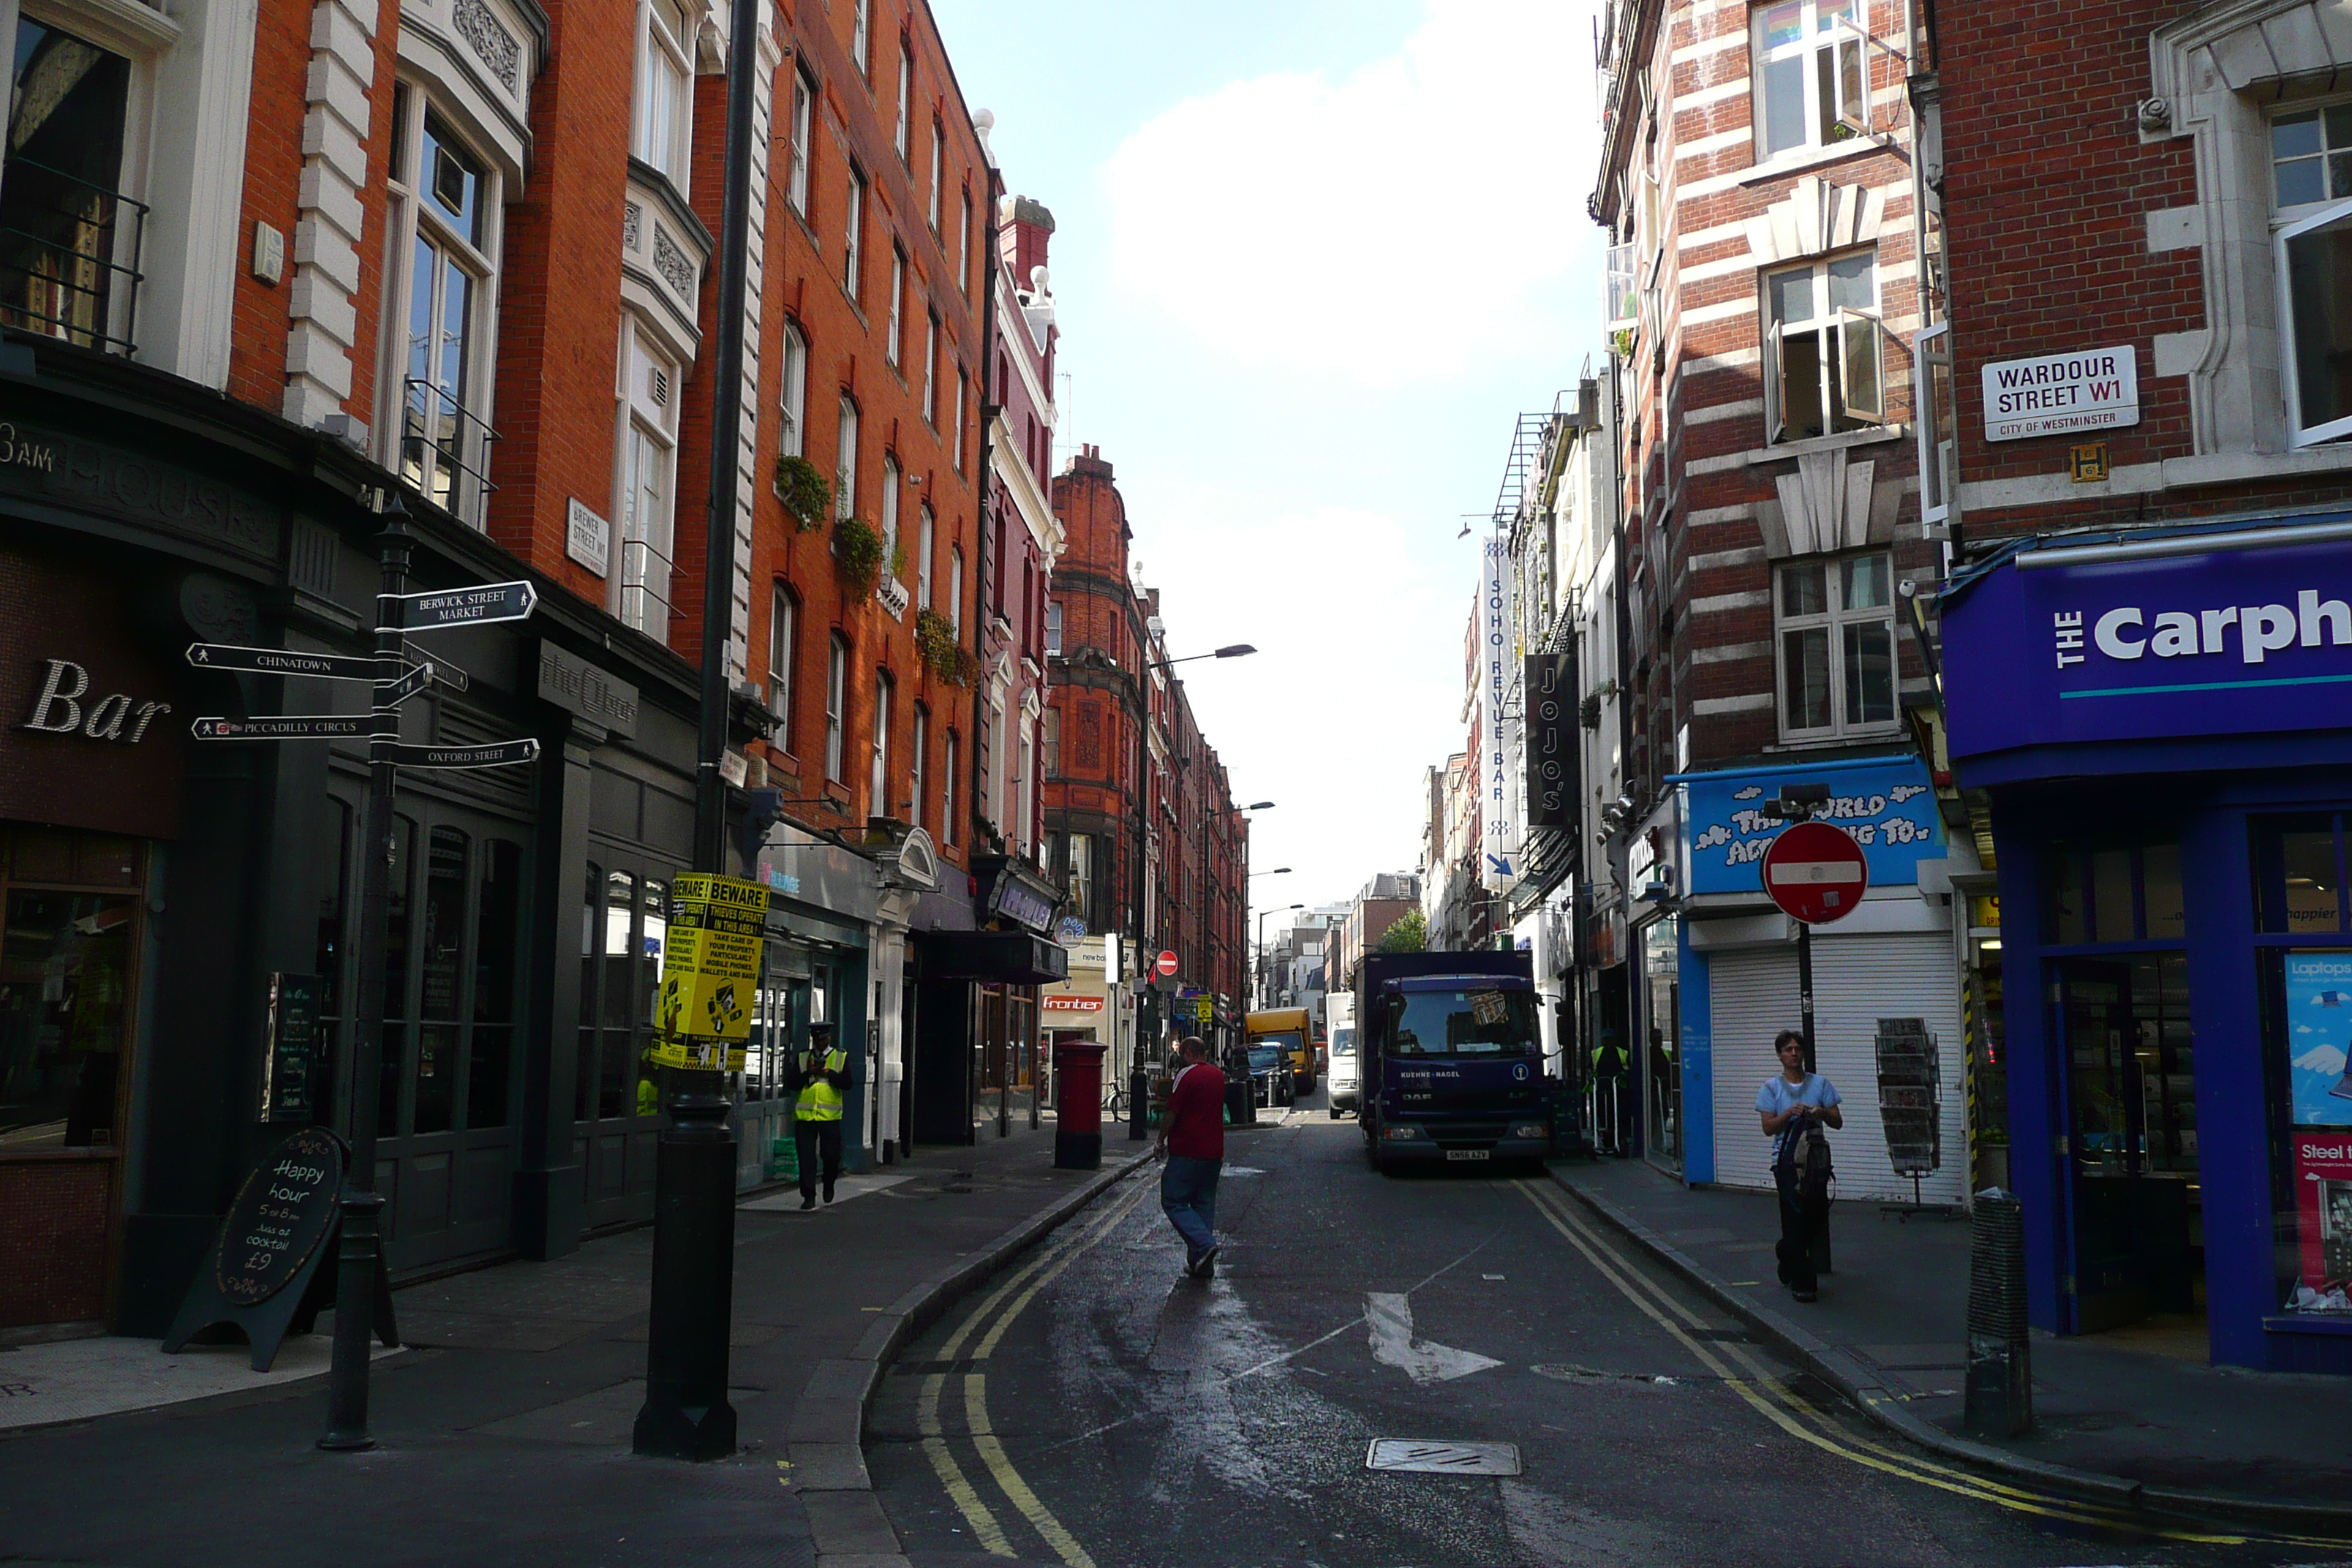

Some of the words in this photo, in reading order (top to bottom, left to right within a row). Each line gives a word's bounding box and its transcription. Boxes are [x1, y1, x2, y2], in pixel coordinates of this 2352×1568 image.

[1997, 356, 2115, 388] WARDOUR
[1999, 385, 2079, 412] STREET
[2089, 380, 2121, 402] W1
[2000, 423, 2021, 435] CITY
[2027, 422, 2038, 431] OF
[2042, 412, 2116, 430] WESTMINSTER
[573, 505, 599, 535] BREWER
[573, 524, 596, 551] STREET
[597, 540, 606, 557] W1
[420, 595, 464, 610] BERWICK
[468, 590, 507, 604] STREET
[439, 606, 486, 621] MARKET
[1490, 579, 1504, 646] SOHO
[2054, 611, 2085, 669] THE
[257, 655, 332, 671] CHINATOWN
[24, 658, 172, 743] Bar
[1491, 661, 1504, 740] REVUE
[244, 723, 311, 732] PICCADILLY
[315, 722, 357, 732] CIRCUS
[1539, 668, 1564, 810] JOJO'S
[428, 751, 471, 762] OXFORD
[475, 748, 505, 760] STREET
[1493, 752, 1505, 801] BAR
[674, 880, 704, 897] BEWARE
[711, 882, 763, 907] BEWARE
[710, 905, 738, 920] THIEVES
[738, 911, 765, 924] OPERATE
[714, 919, 722, 930] IN
[723, 920, 736, 932] THIS
[709, 941, 725, 950] YOUR
[726, 944, 755, 954] PROPERTY,
[731, 935, 745, 944] CARE
[706, 959, 728, 968] MOBILE
[729, 962, 753, 971] PHONES,
[710, 951, 753, 962] PARTICULARLY
[699, 967, 728, 976] WALLETS
[742, 972, 756, 980] BAGS
[2291, 962, 2352, 976] Laptops
[2302, 1144, 2343, 1159] Steel
[273, 1159, 325, 1185] Happy
[268, 1183, 310, 1204] hour
[259, 1204, 270, 1215] 5
[279, 1207, 290, 1219] 8
[246, 1235, 290, 1251] cocktail
[245, 1251, 272, 1271] £9
